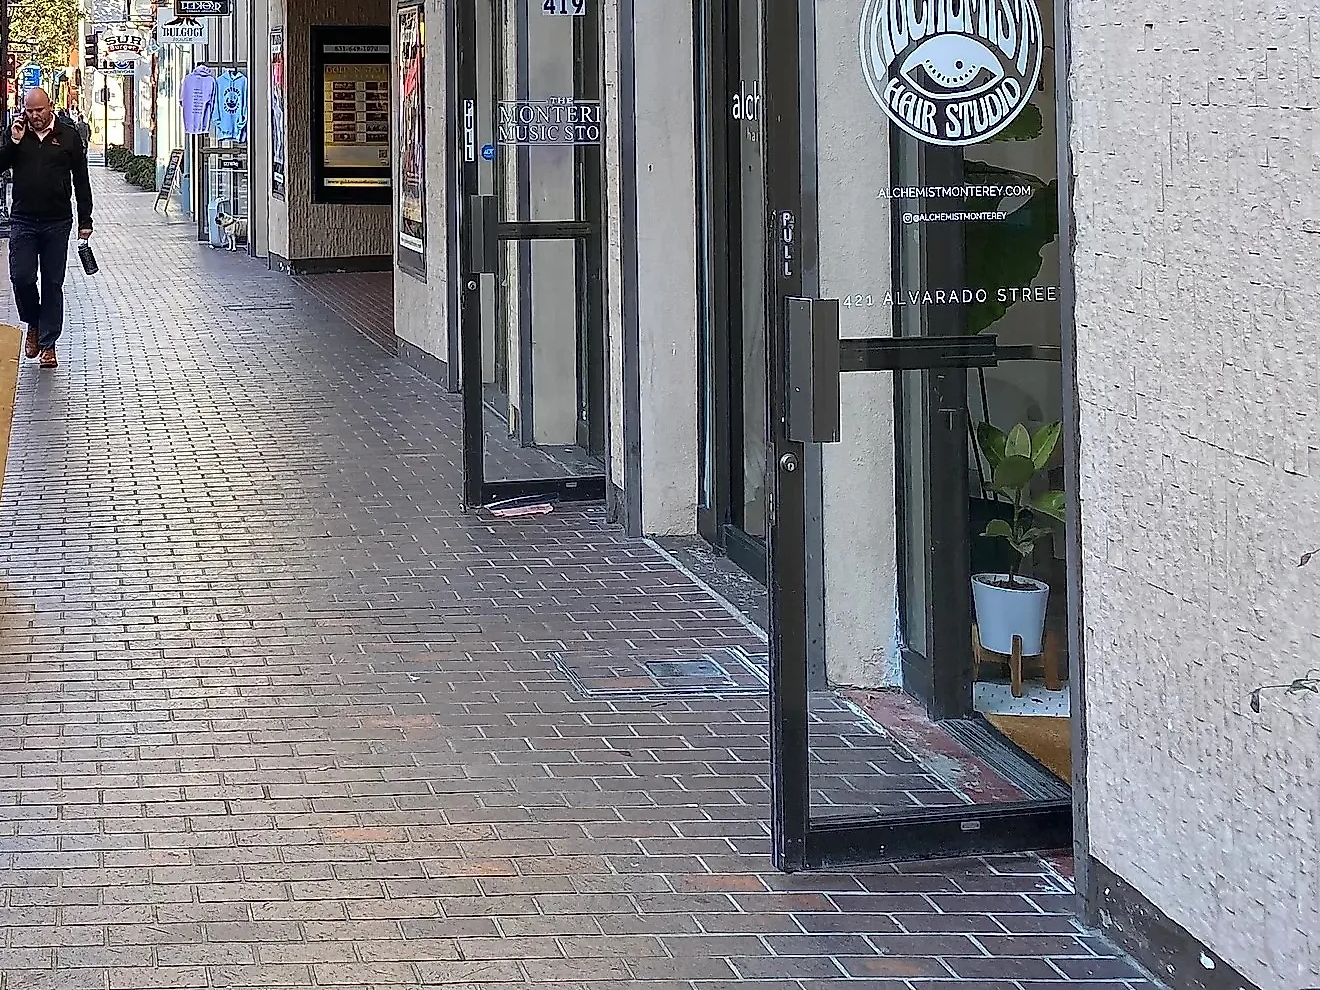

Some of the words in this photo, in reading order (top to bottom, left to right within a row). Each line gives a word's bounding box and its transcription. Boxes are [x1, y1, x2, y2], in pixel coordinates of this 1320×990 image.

[550, 97, 573, 105] THE
[884, 77, 938, 136] HAIR
[945, 76, 1021, 138] STUDIO
[465, 101, 473, 160] PULL
[498, 125, 558, 141] MUSIC
[878, 185, 1031, 199] ALCHEMISTMONTEREY.COM
[912, 212, 1007, 223] @ALCHEMISTMONTEREY
[783, 212, 792, 276] PULL
[843, 294, 874, 308] 421
[883, 288, 987, 306] ALVARADO
